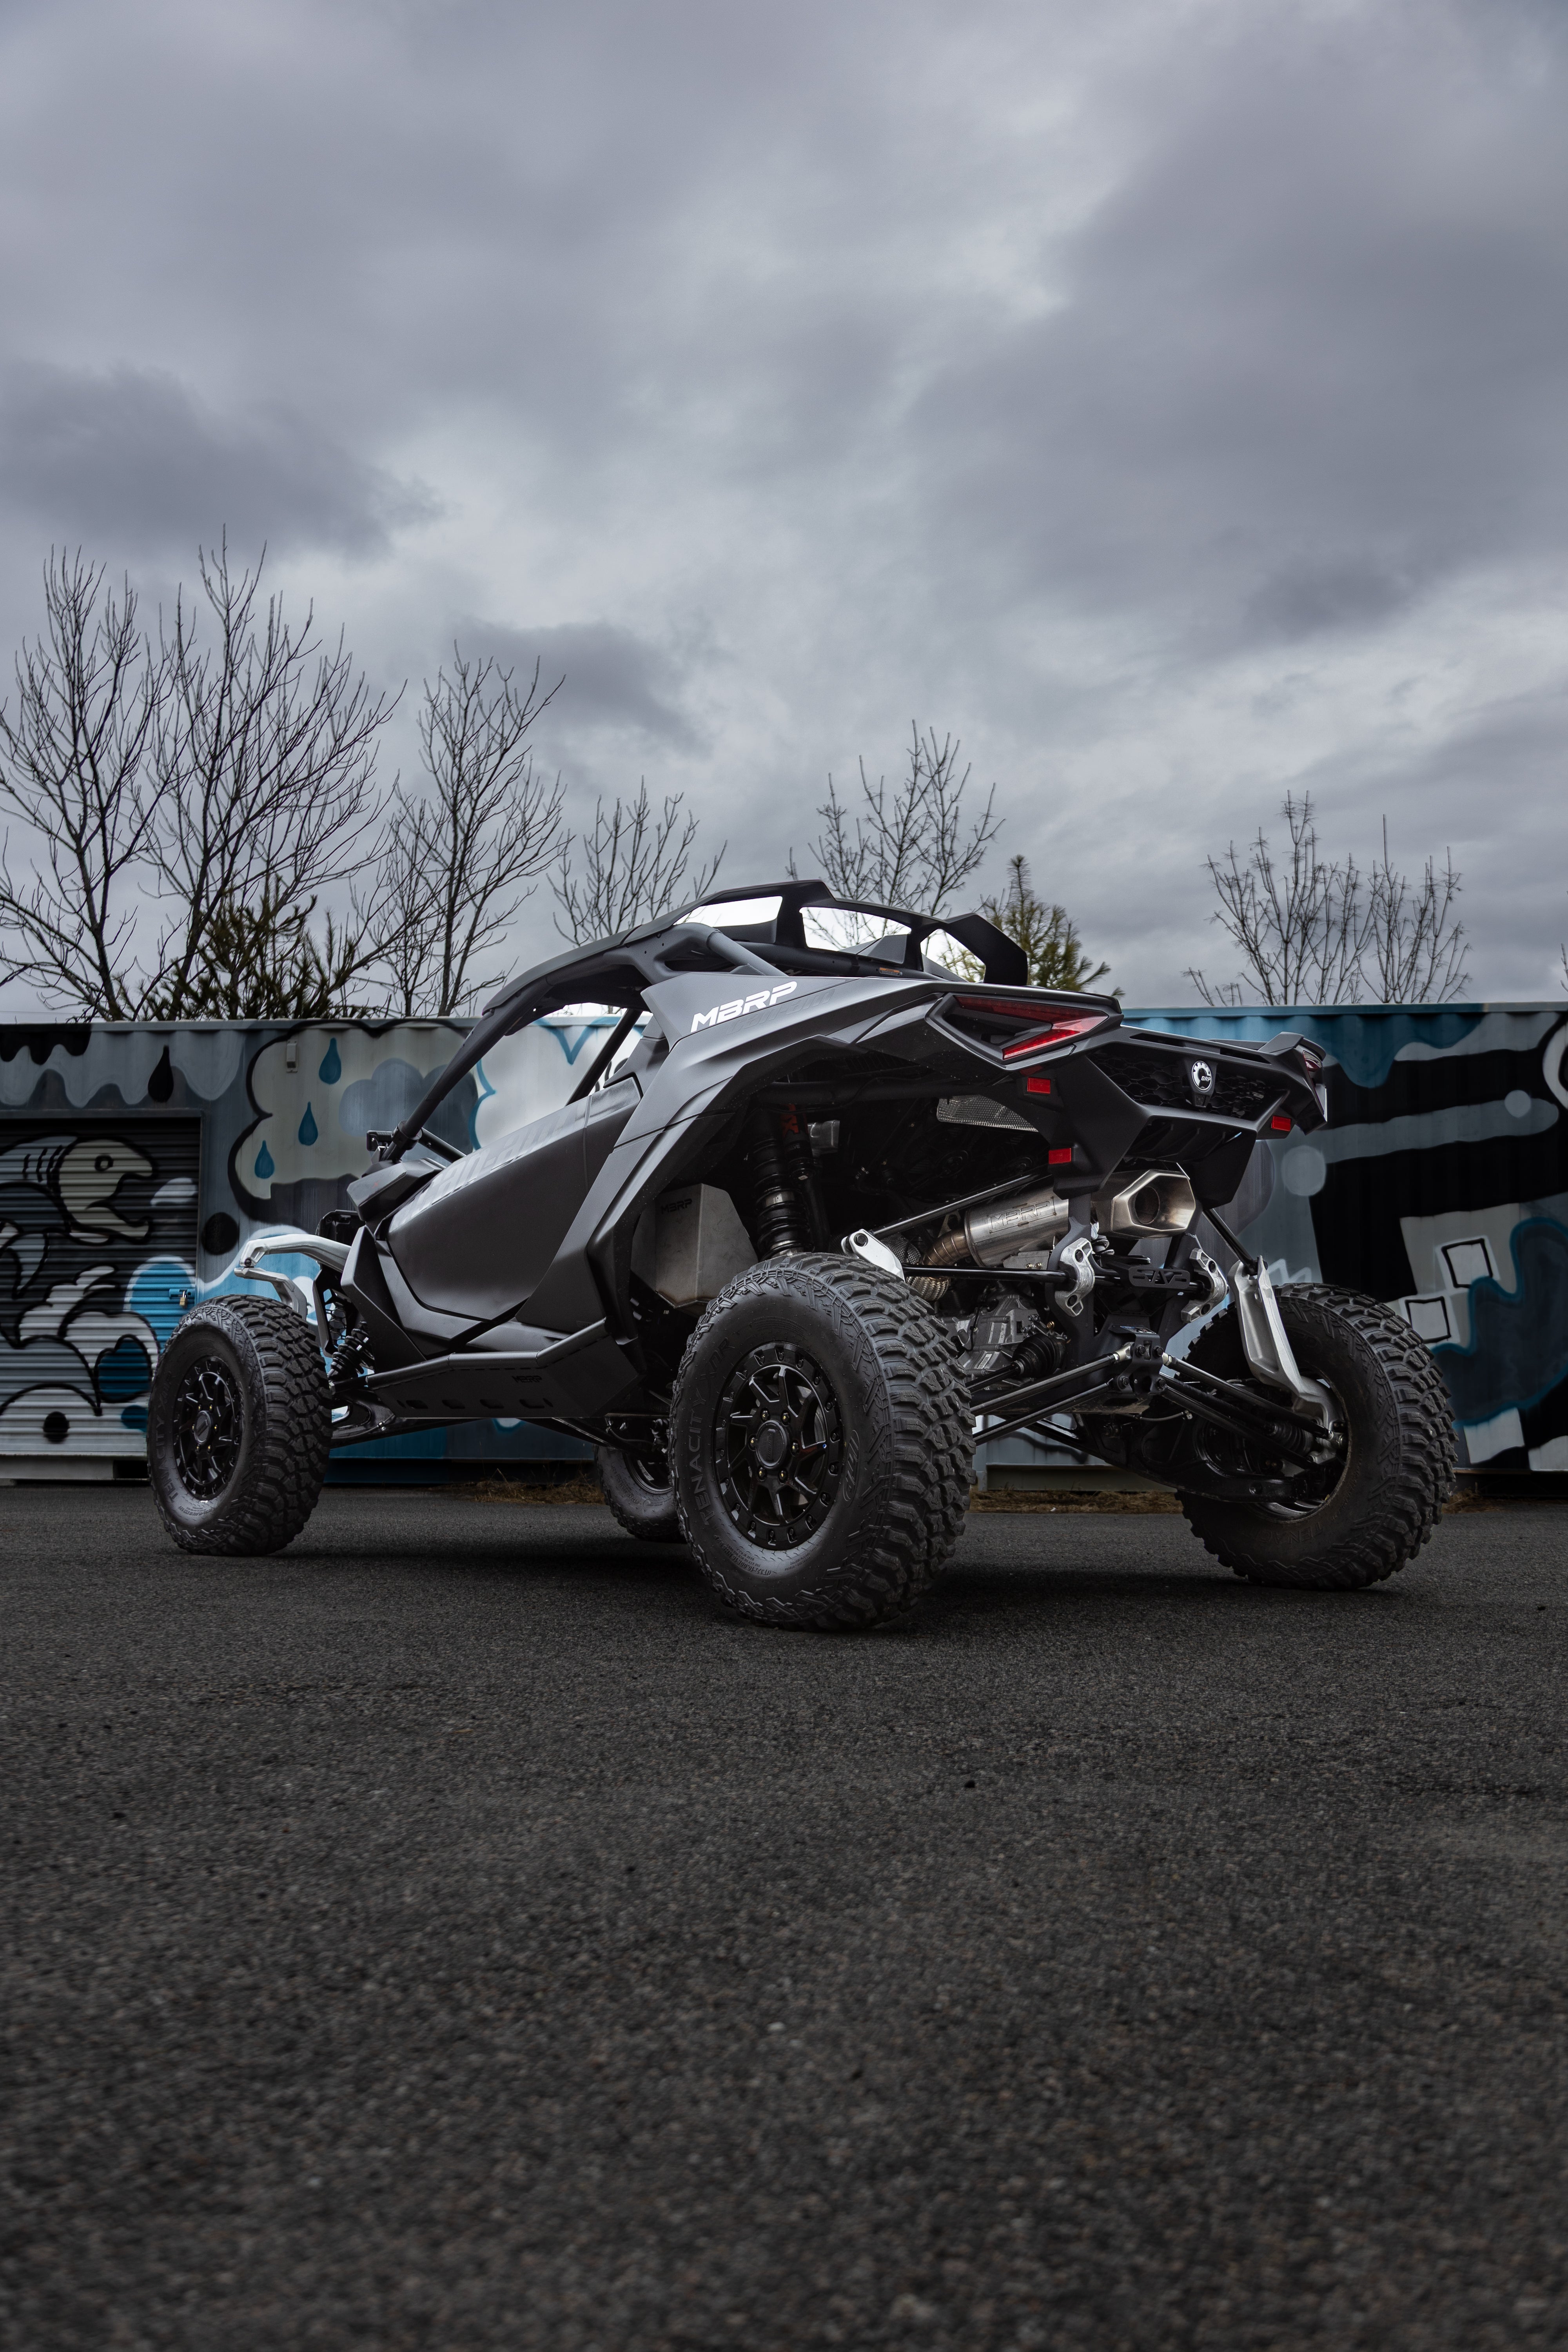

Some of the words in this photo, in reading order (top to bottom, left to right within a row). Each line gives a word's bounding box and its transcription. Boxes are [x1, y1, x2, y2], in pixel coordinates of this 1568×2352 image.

[690, 981, 797, 1033] MBRP
[661, 1198, 693, 1214] MBRP
[990, 1201, 1051, 1229] MBRP
[155, 1414, 179, 1503] TENACITY
[688, 1387, 715, 1526] TENACITY
